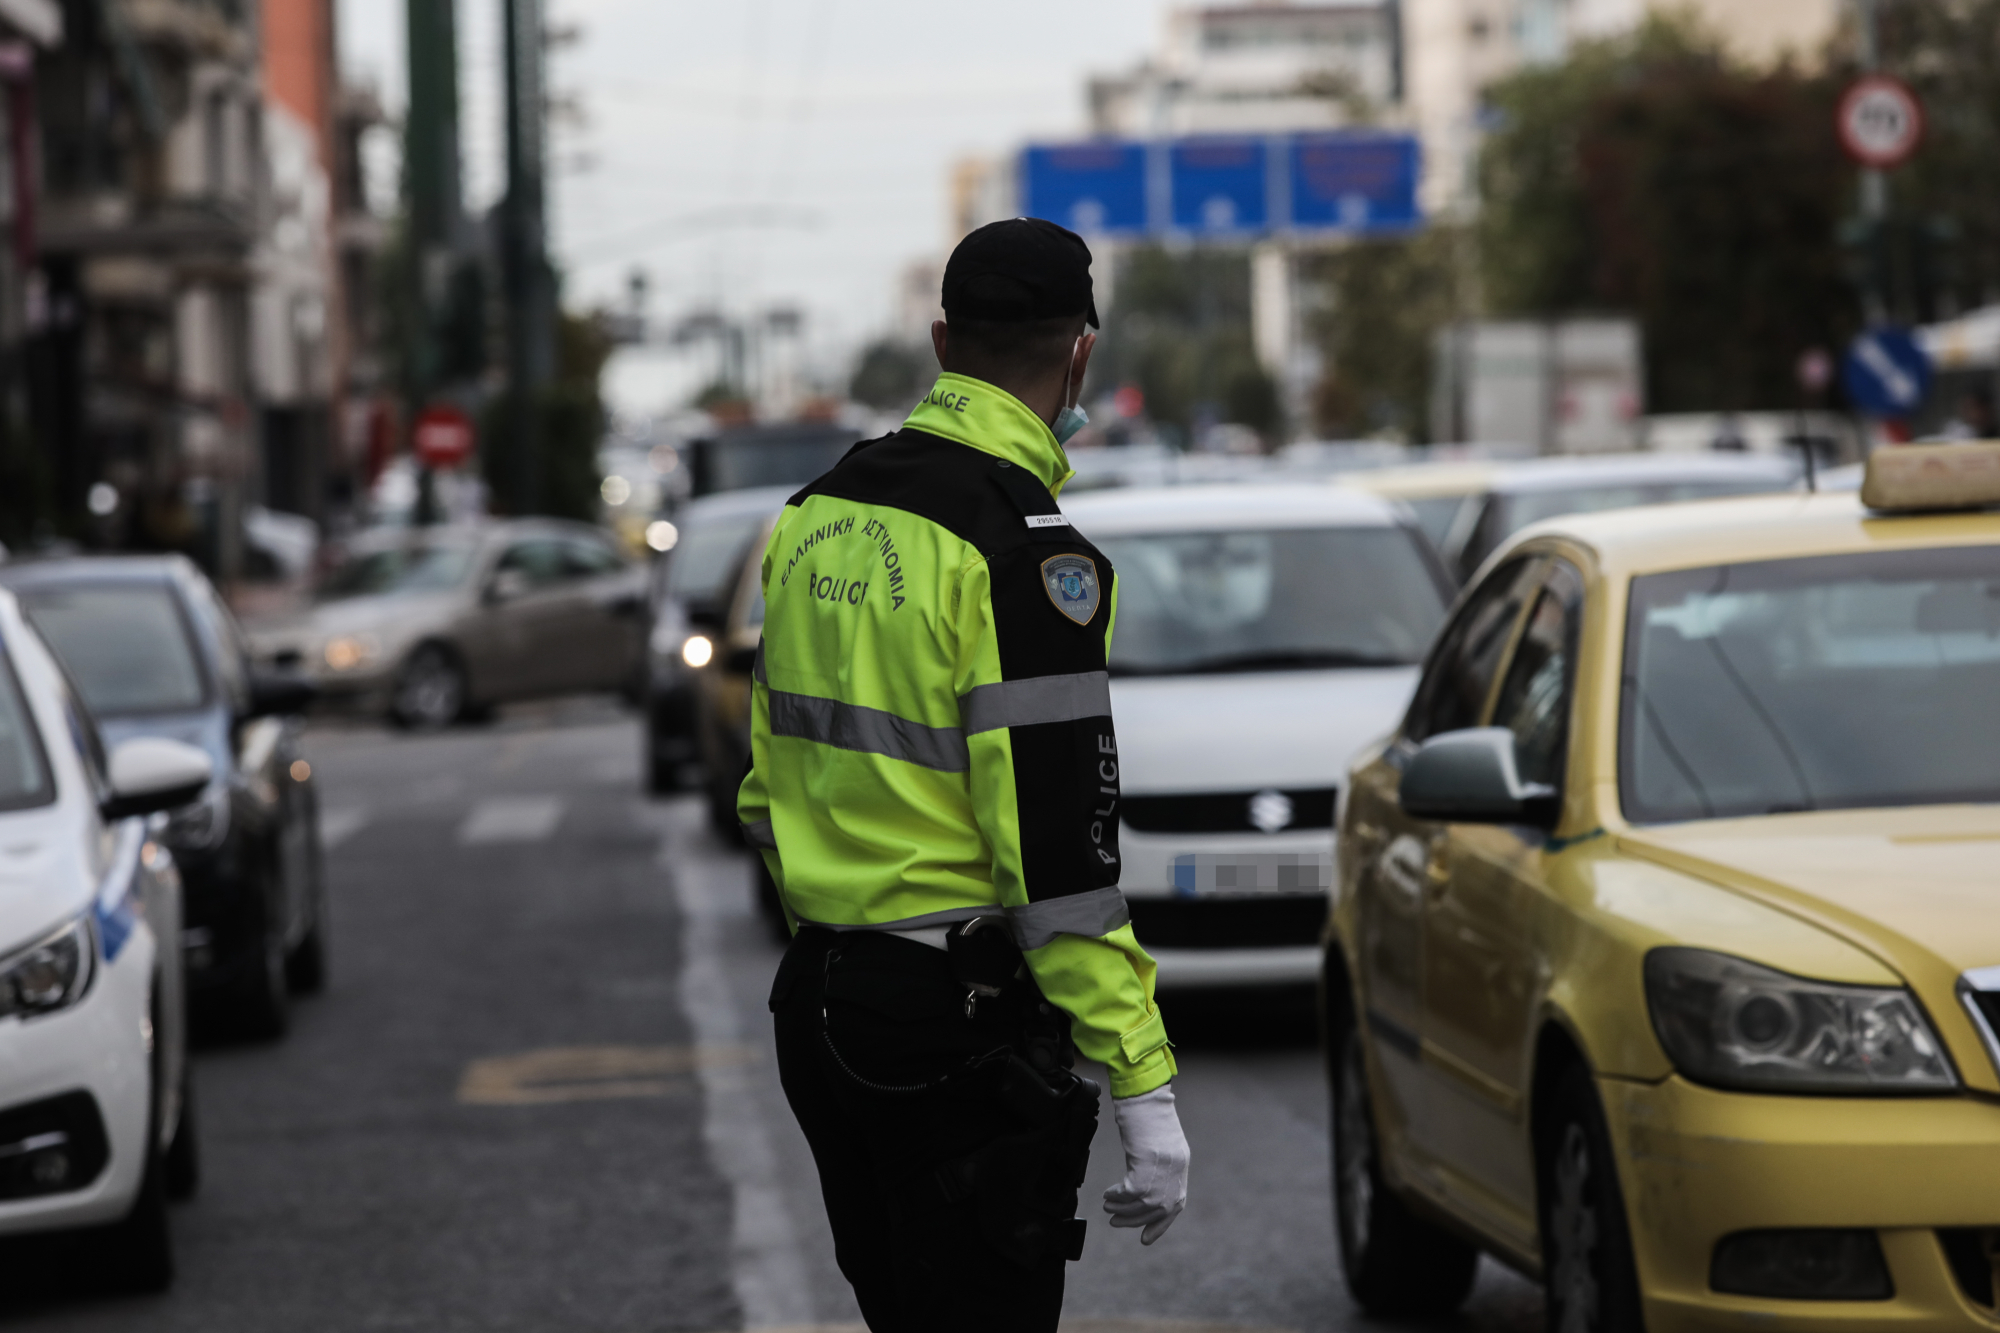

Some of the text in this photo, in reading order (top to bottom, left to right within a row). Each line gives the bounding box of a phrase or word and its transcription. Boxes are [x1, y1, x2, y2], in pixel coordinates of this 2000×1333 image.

[781, 517, 906, 612] ΕΛΛΗΝΙΚΗ ΑΣΤΥΝΟΜΙΑ
[1091, 734, 1118, 864] POLICE
